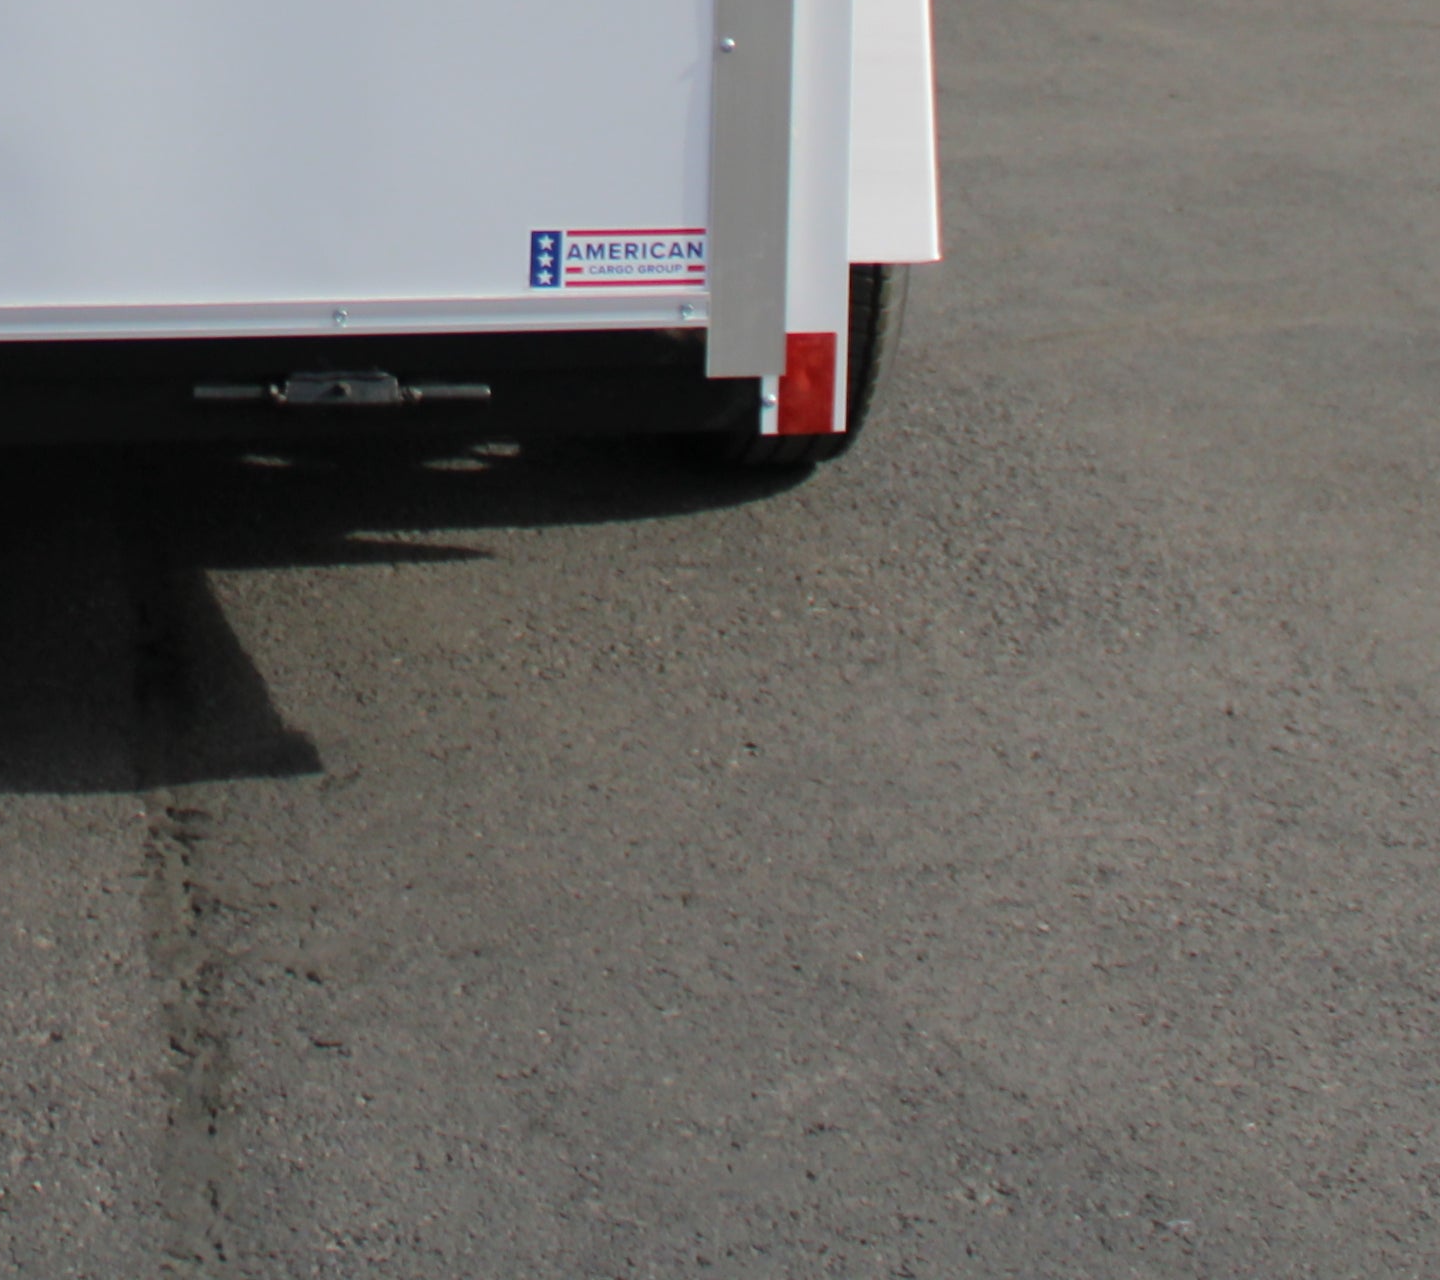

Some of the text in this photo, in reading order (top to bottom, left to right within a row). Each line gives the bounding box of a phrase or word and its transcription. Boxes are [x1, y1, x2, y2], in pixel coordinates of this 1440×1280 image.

[566, 242, 704, 261] AMERICAN
[589, 263, 684, 275] CARGO GROUP
